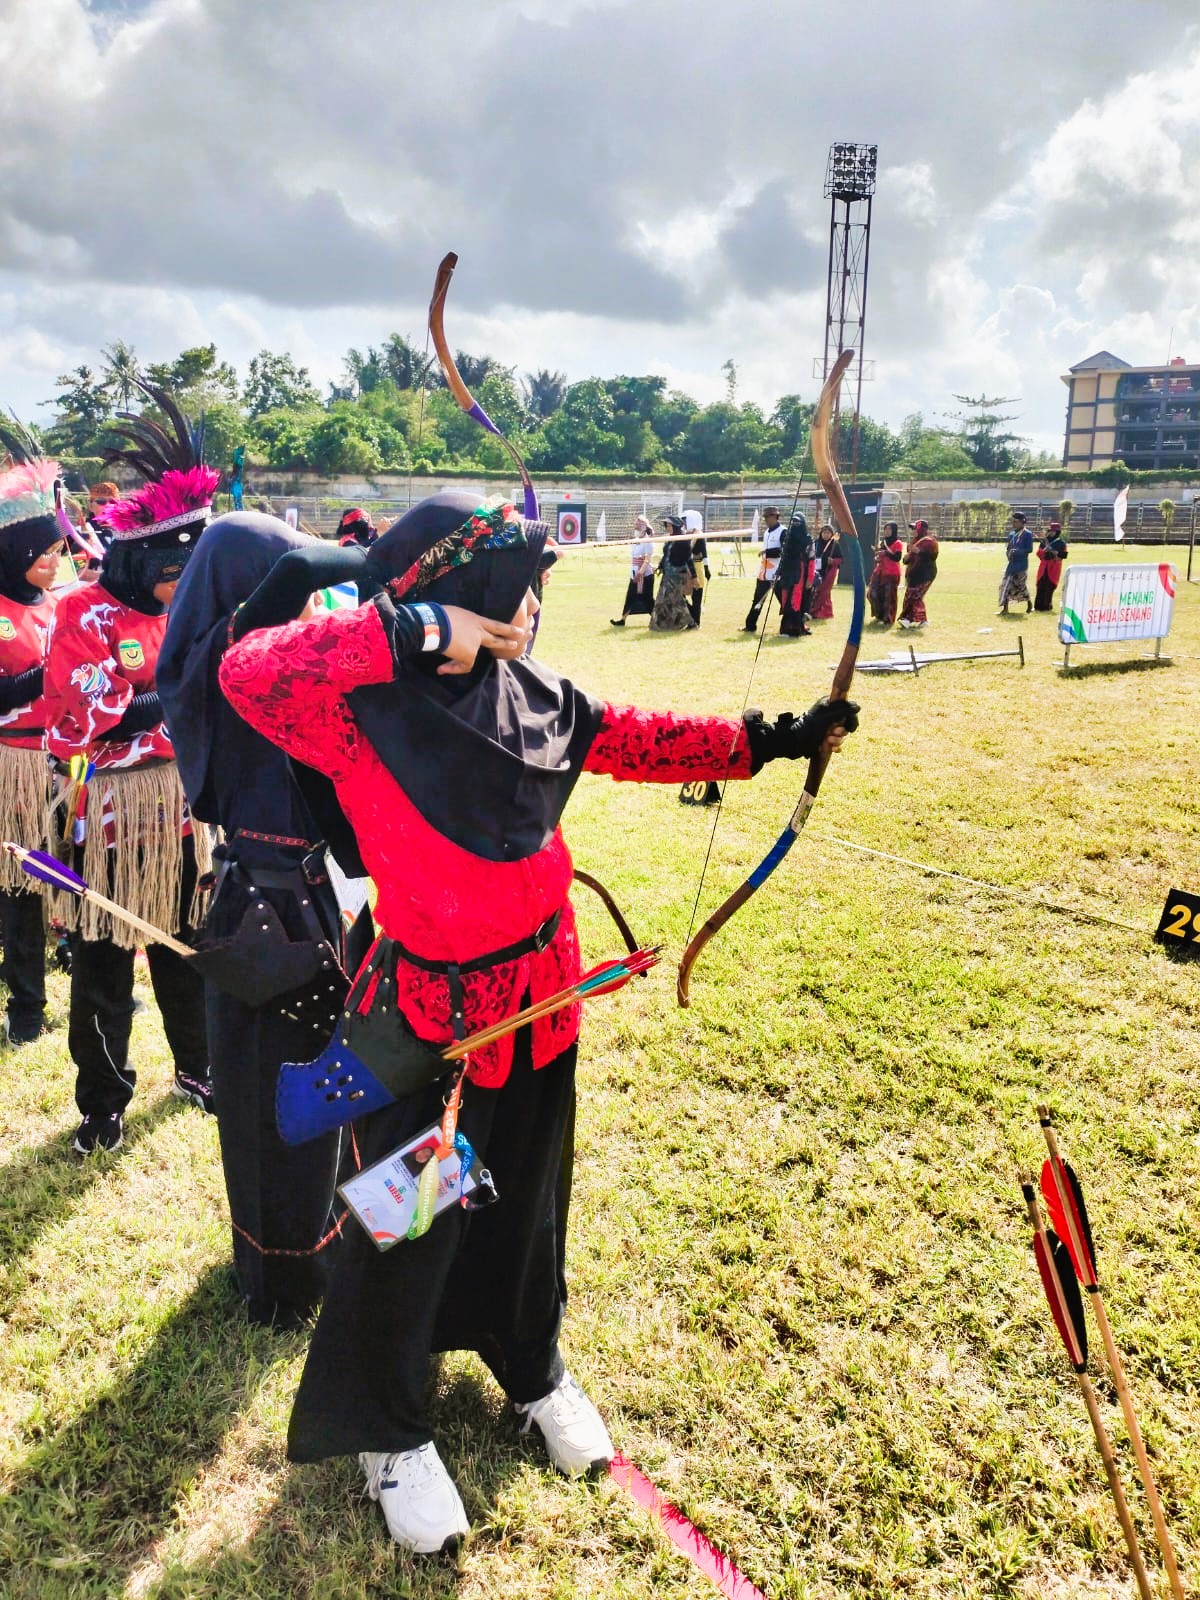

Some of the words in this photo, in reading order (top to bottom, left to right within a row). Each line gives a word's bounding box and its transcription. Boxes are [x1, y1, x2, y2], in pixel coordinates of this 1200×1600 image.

[1120, 591, 1154, 605] MENANG
[1087, 608, 1117, 624] SEMUA
[1120, 607, 1152, 622] SENANG
[683, 781, 707, 801] 30
[445, 1109, 455, 1143] 2025
[421, 1156, 437, 1233] TBMakmurMe
